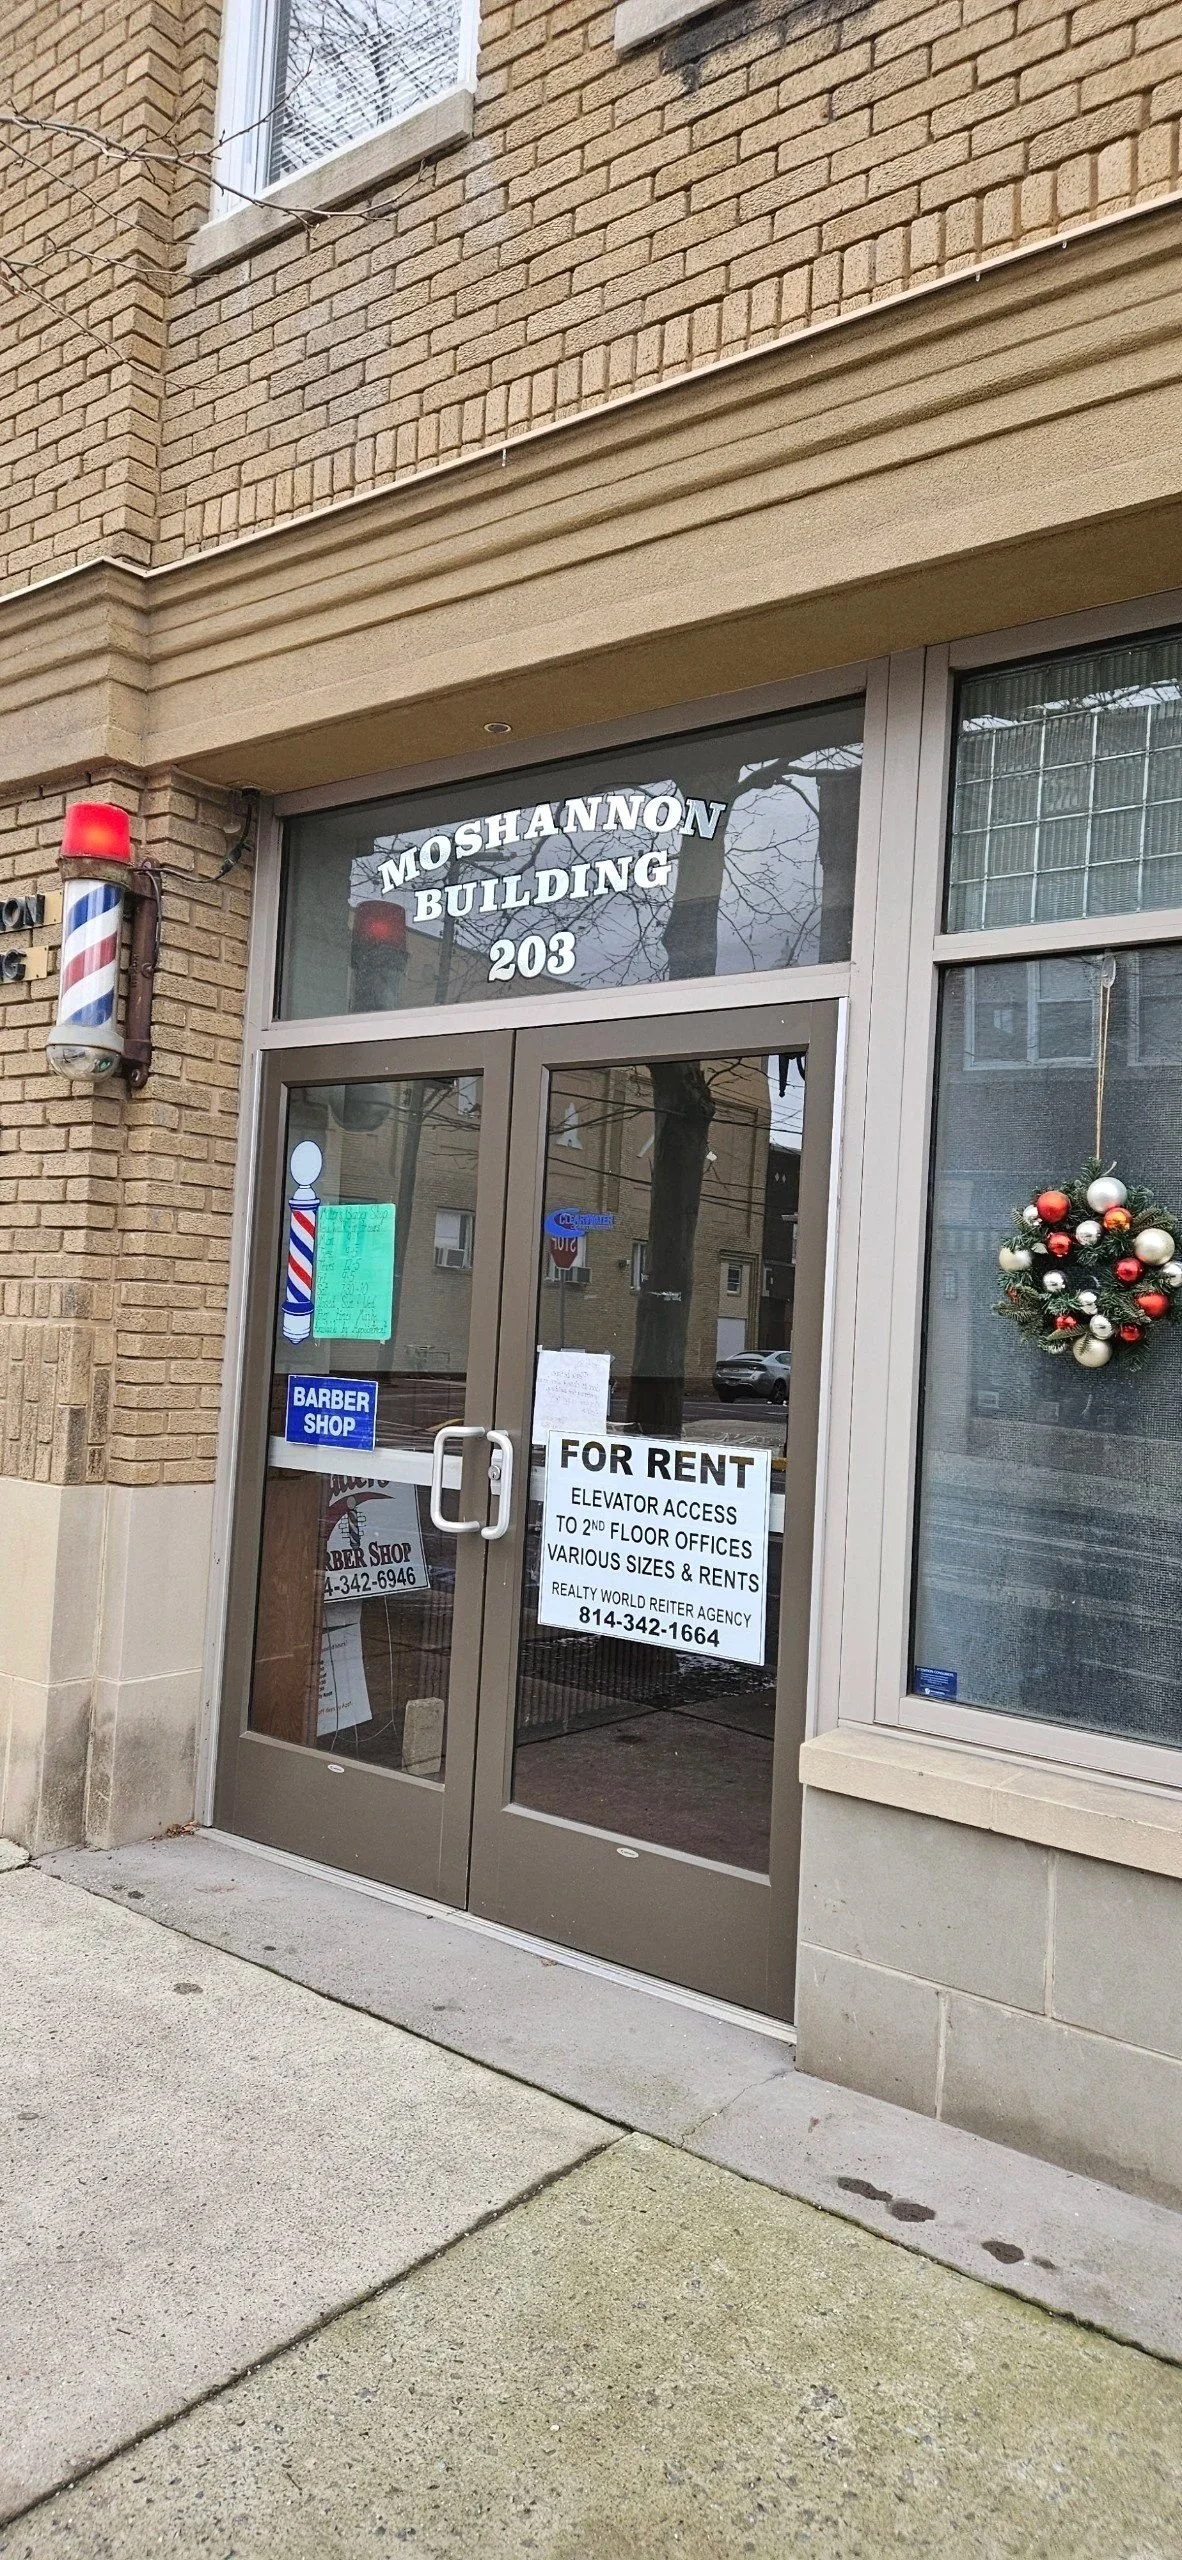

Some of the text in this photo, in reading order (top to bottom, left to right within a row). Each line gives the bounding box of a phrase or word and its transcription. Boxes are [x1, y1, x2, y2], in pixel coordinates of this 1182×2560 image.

[377, 793, 727, 895] MOSHANNON
[412, 849, 674, 923] BUILDING
[0, 894, 45, 932] ON
[487, 931, 577, 983] 203
[293, 1386, 370, 1413] BARBER
[304, 1412, 356, 1437] SHOP
[560, 1438, 755, 1489] FOR RENT
[571, 1487, 738, 1526] ELEVATOR ACCESS
[369, 1541, 412, 1567] SHOP
[556, 1515, 577, 1535] TO
[610, 1523, 669, 1548] FLOOR
[675, 1532, 753, 1560] OFFICES
[547, 1543, 760, 1593] VARIOUS SIZES & RENTS
[551, 1582, 753, 1629] REALTY WORLD REITER AGENCY
[578, 1606, 720, 1648] 814-342-1664
